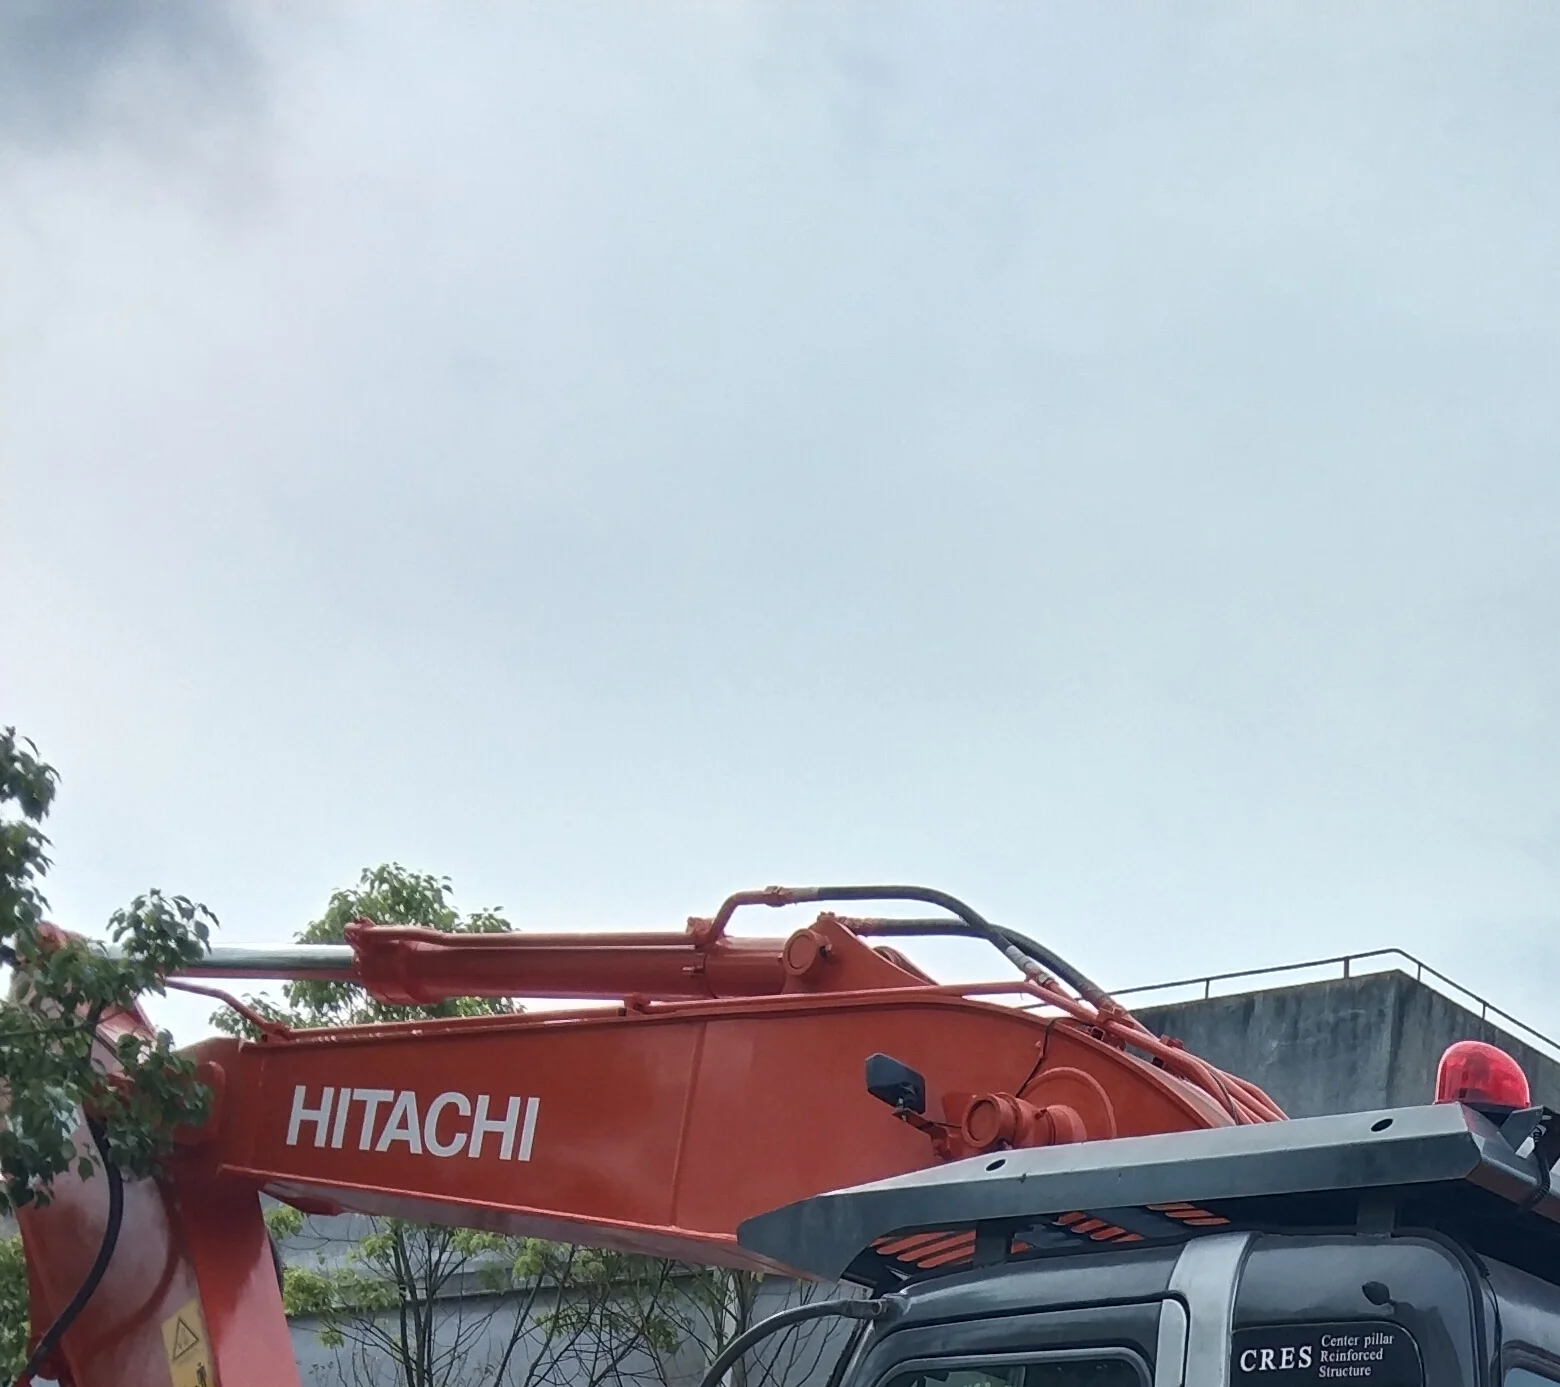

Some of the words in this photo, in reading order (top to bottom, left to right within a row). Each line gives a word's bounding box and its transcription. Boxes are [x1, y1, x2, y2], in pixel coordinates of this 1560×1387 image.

[286, 1085, 540, 1162] HITACHI
[1321, 1333, 1360, 1348] Center
[1363, 1333, 1394, 1348] pillar
[1239, 1345, 1313, 1373] CRES
[1320, 1348, 1383, 1363] Reinforced
[1319, 1363, 1372, 1378] Structure
